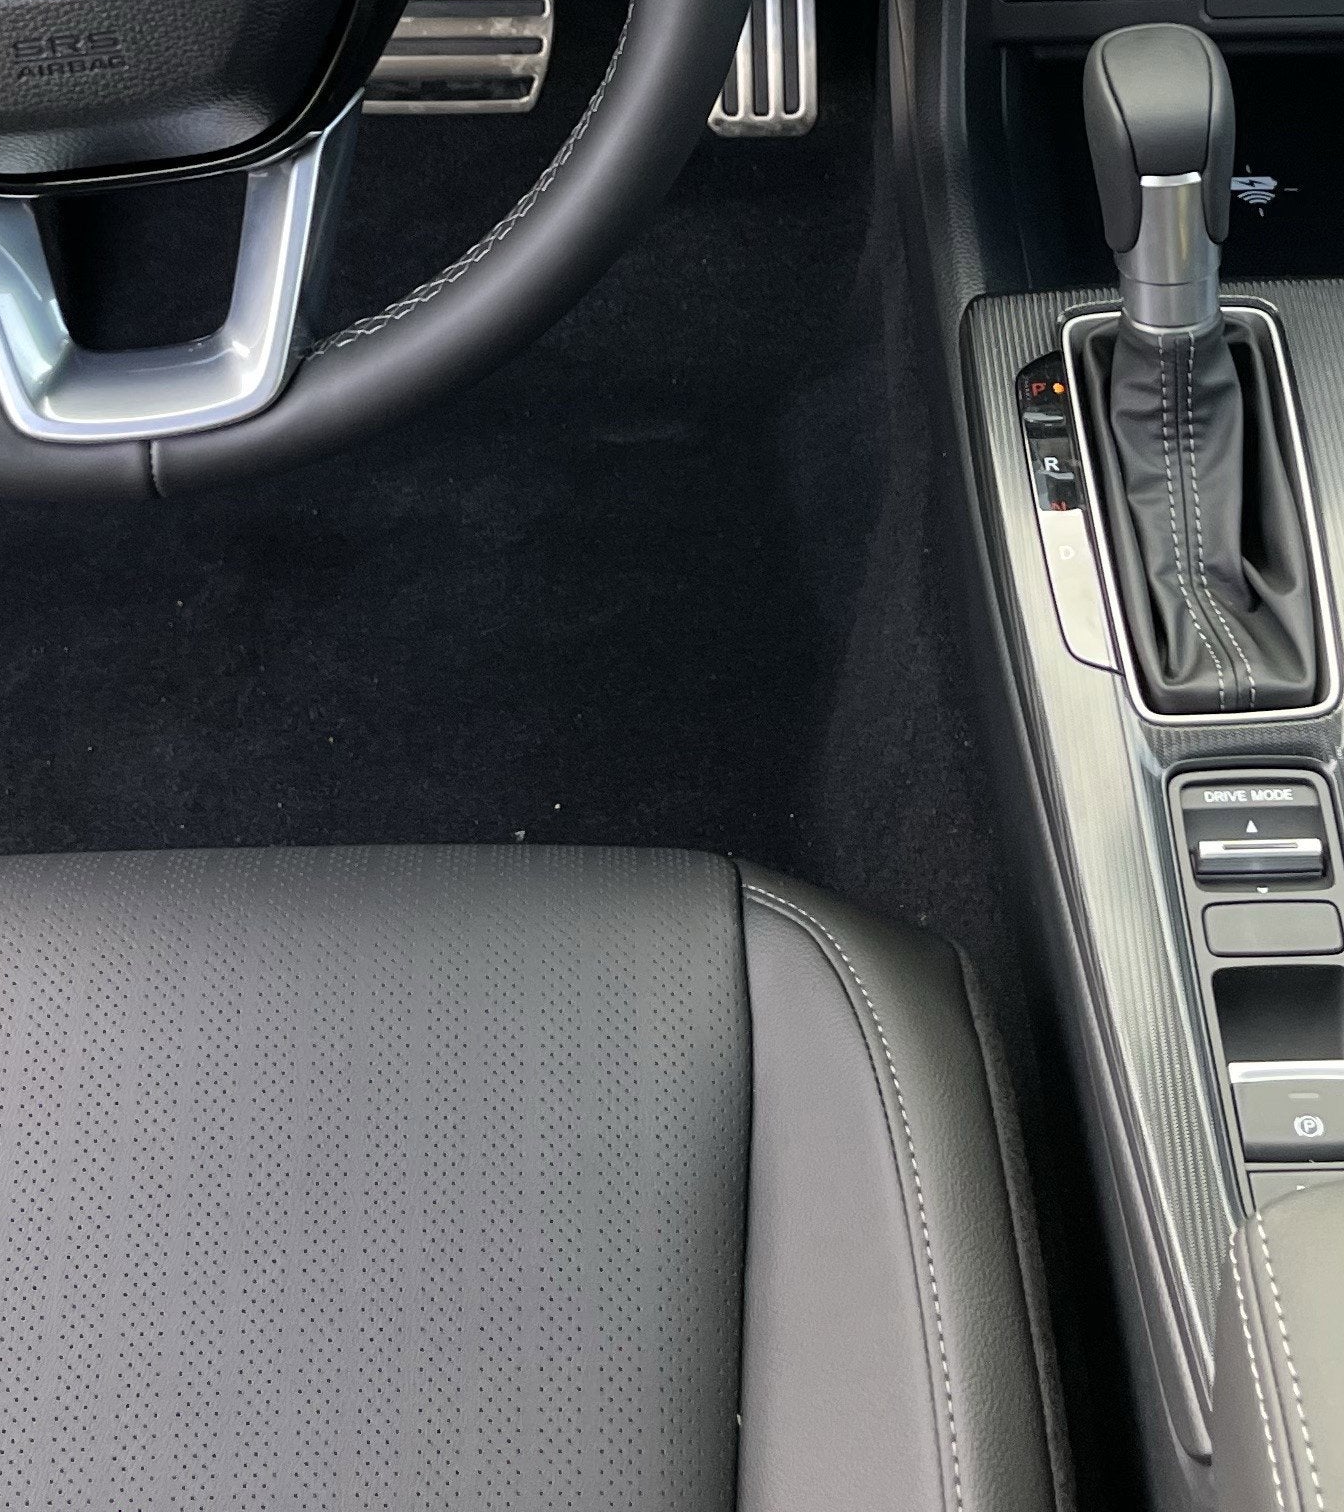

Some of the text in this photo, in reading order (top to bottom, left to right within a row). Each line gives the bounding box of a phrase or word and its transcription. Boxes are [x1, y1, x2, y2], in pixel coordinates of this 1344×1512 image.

[17, 57, 126, 80] AIRBAG
[1031, 382, 1047, 397] P
[1043, 456, 1060, 472] R
[1203, 787, 1293, 803] DRIVE MODE
